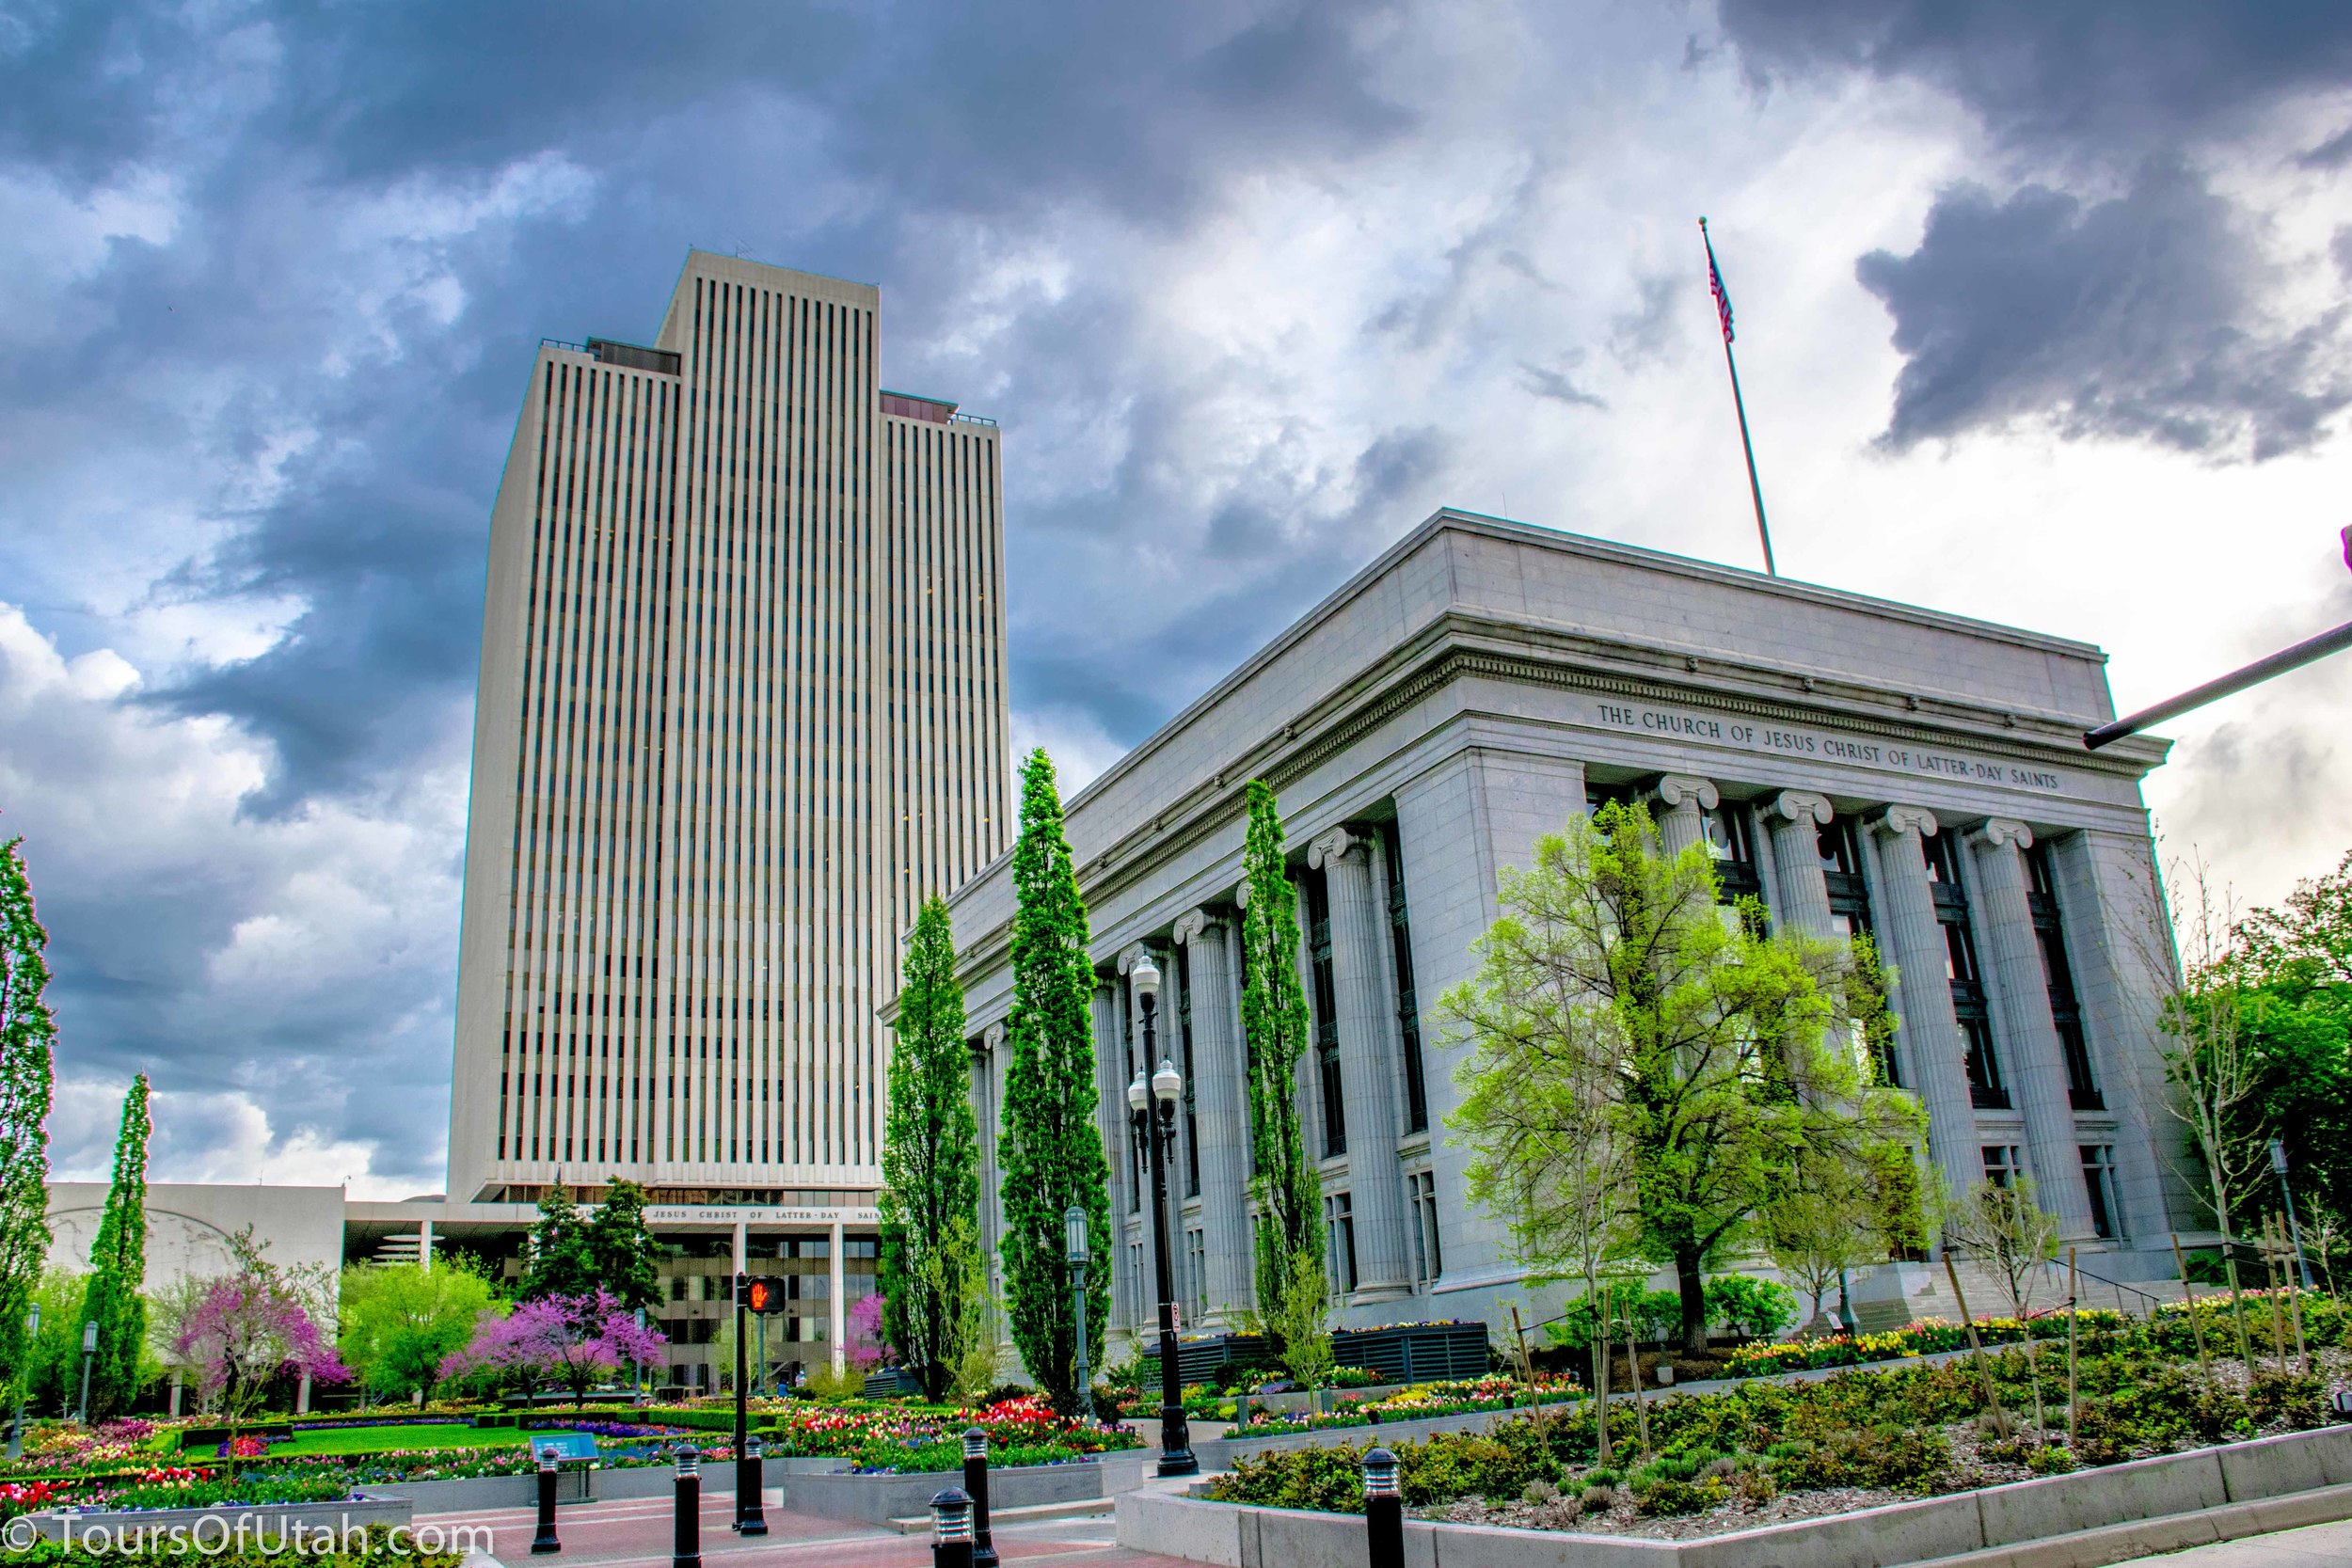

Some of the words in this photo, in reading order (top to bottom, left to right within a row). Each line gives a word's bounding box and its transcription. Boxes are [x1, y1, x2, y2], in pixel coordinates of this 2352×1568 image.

[1597, 705, 1634, 725] THE
[1643, 712, 1721, 738] CHURCH
[1731, 725, 1753, 743] OF
[1763, 730, 1815, 752] JESUS
[1823, 739, 1880, 762] CHRIST
[1888, 750, 1909, 767] OF
[1916, 753, 2003, 782] LATTER-DAY
[2010, 768, 2058, 789] SAINTS
